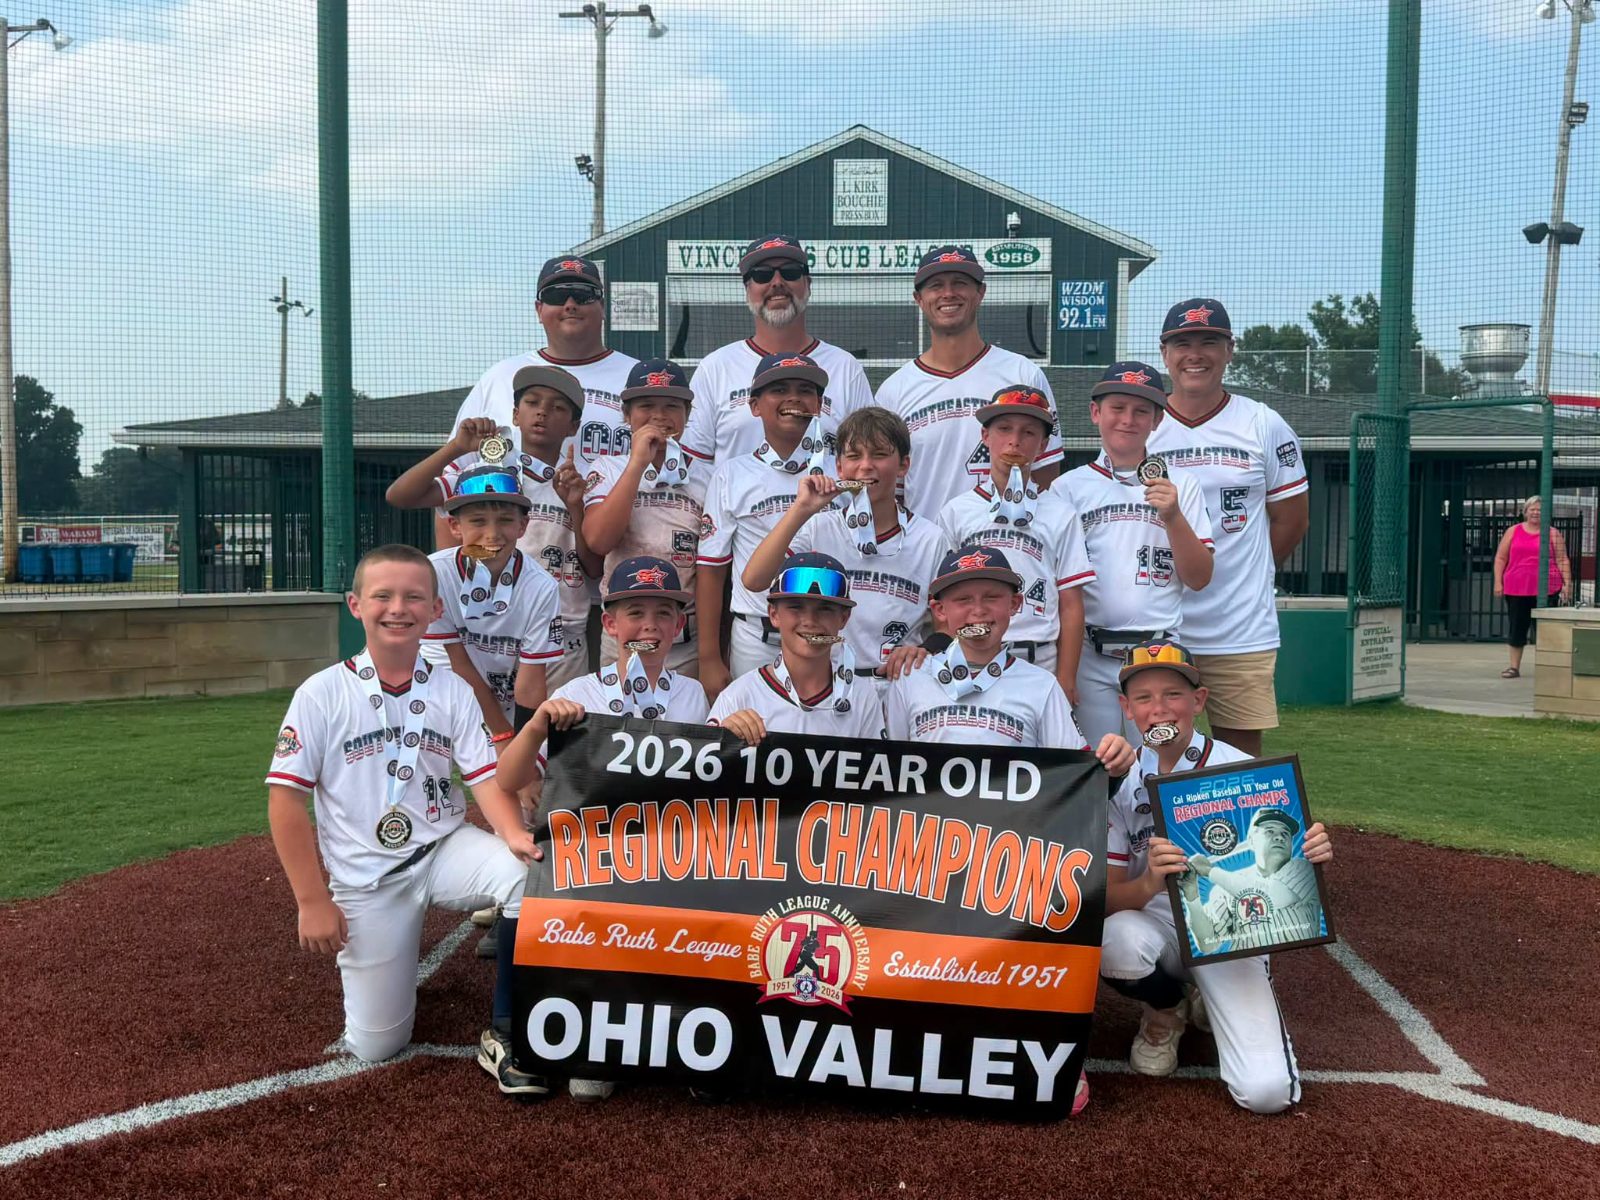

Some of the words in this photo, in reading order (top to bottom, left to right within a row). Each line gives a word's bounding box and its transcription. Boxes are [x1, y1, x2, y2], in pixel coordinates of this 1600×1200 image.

[837, 195, 885, 208] BOUCHIE
[854, 180, 878, 193] KIRK
[826, 244, 871, 268] CUB
[991, 252, 1034, 264] 1958
[1061, 281, 1105, 295] WZDM
[1061, 295, 1105, 306] WISDOM
[1059, 307, 1092, 329] 92.1
[1220, 486, 1250, 533] 5
[1135, 544, 1175, 587] 15
[880, 620, 910, 663] 2
[1360, 636, 1394, 647] ENTRANCE
[1363, 626, 1391, 636] OFFICIAL
[915, 704, 1025, 744] SOUTHEASTERN
[605, 732, 723, 782] 2026
[740, 744, 792, 786] 10
[803, 748, 927, 795] YEAR
[938, 755, 1042, 803] OLD
[1199, 774, 1255, 793] 2026
[422, 775, 465, 823] 12
[1173, 795, 1184, 805] Cal
[1186, 792, 1210, 803] Ripken
[1212, 785, 1242, 798] Baseball
[1243, 784, 1252, 793] 10
[1255, 781, 1270, 792] Year
[1272, 778, 1285, 788] Old
[1173, 798, 1236, 824] REGIONAL
[1237, 789, 1290, 809] CHAMPS
[547, 798, 787, 892] REGIONAL
[796, 800, 1093, 933] CHAMPIONS
[778, 895, 830, 914] LEAGUE
[1240, 897, 1265, 918] 75
[538, 917, 596, 946] Babe
[602, 923, 658, 951] Ruth
[663, 928, 743, 962] League
[750, 908, 780, 942] RUTH
[747, 944, 763, 978] BABE
[780, 921, 843, 987] 75
[830, 903, 871, 992] ANNIVERSARY
[883, 950, 1005, 985] Established
[1006, 963, 1069, 988] 1951
[772, 981, 791, 992] 1951
[820, 985, 841, 1001] 2026
[526, 996, 733, 1072] OHIO
[761, 1013, 1077, 1103] VALLEY
